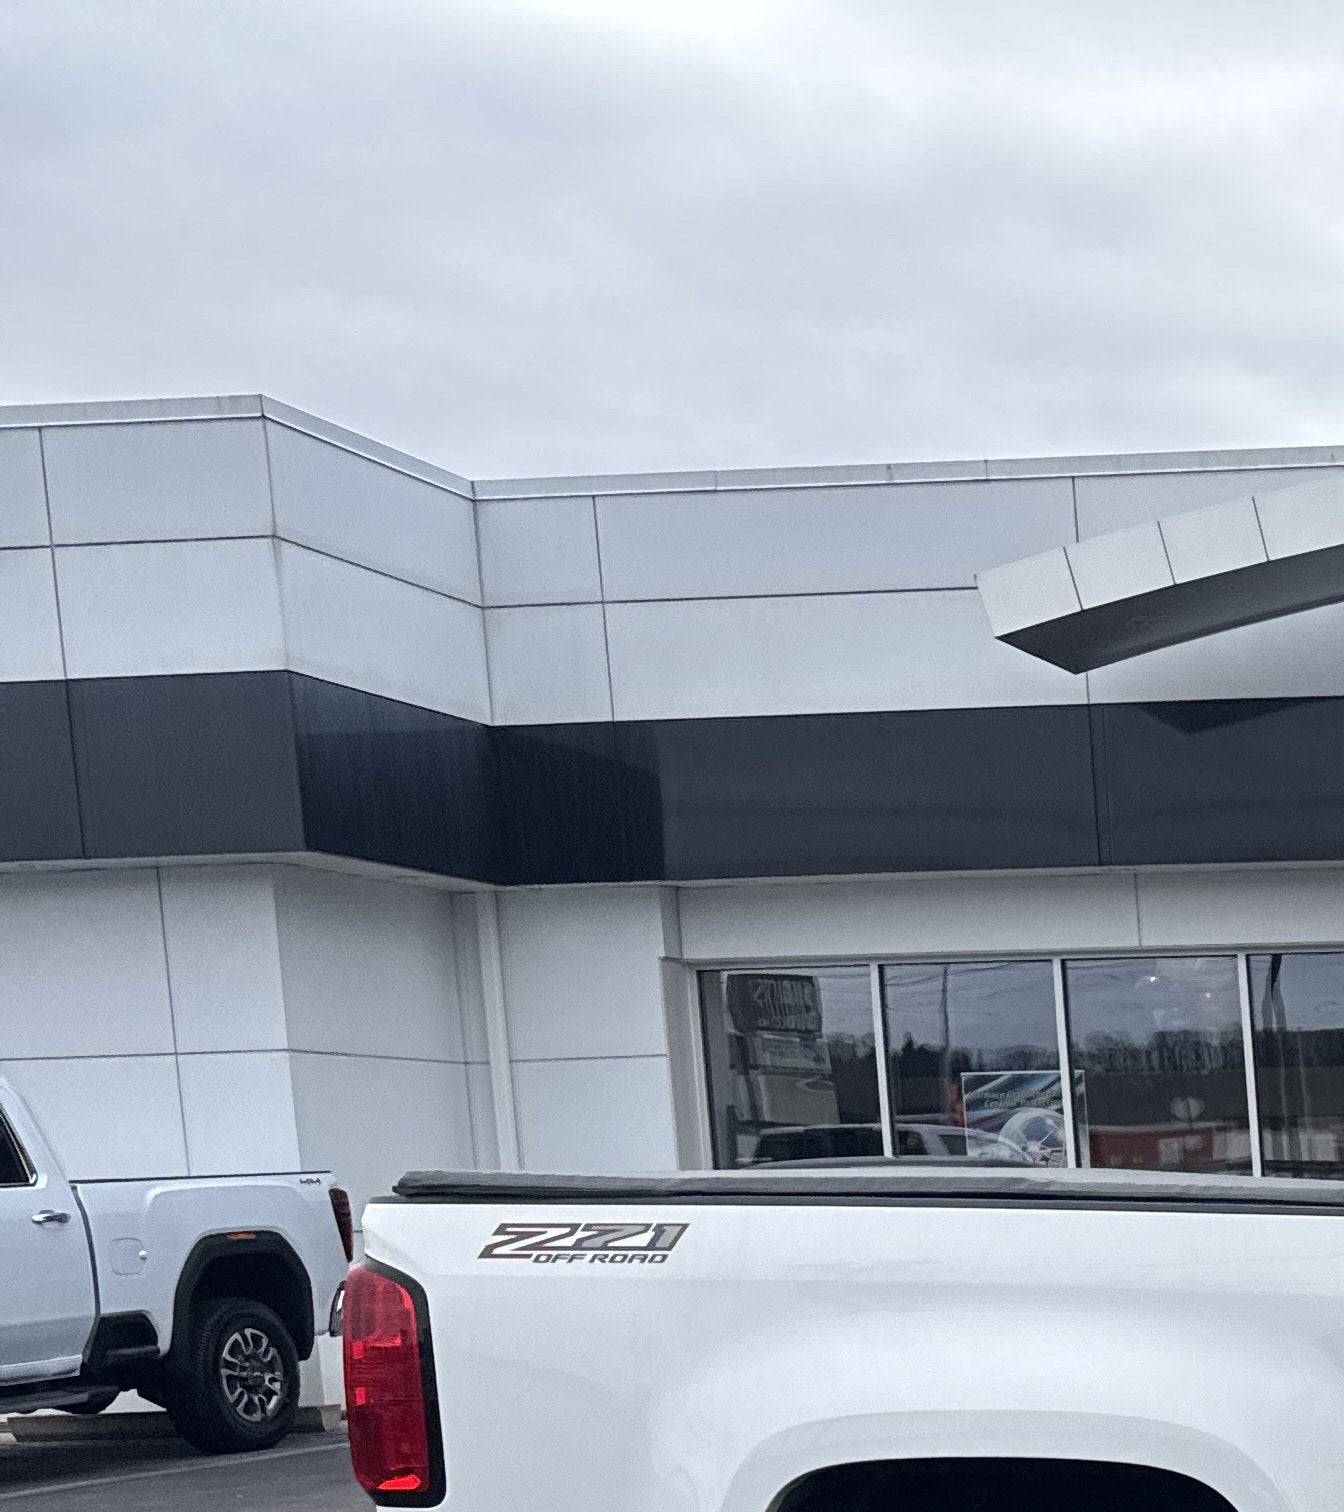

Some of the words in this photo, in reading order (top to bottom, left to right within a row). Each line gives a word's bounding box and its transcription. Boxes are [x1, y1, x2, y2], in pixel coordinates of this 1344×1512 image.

[477, 1222, 691, 1260] Z71
[532, 1253, 588, 1264] OFF
[588, 1253, 670, 1264] ROAD
